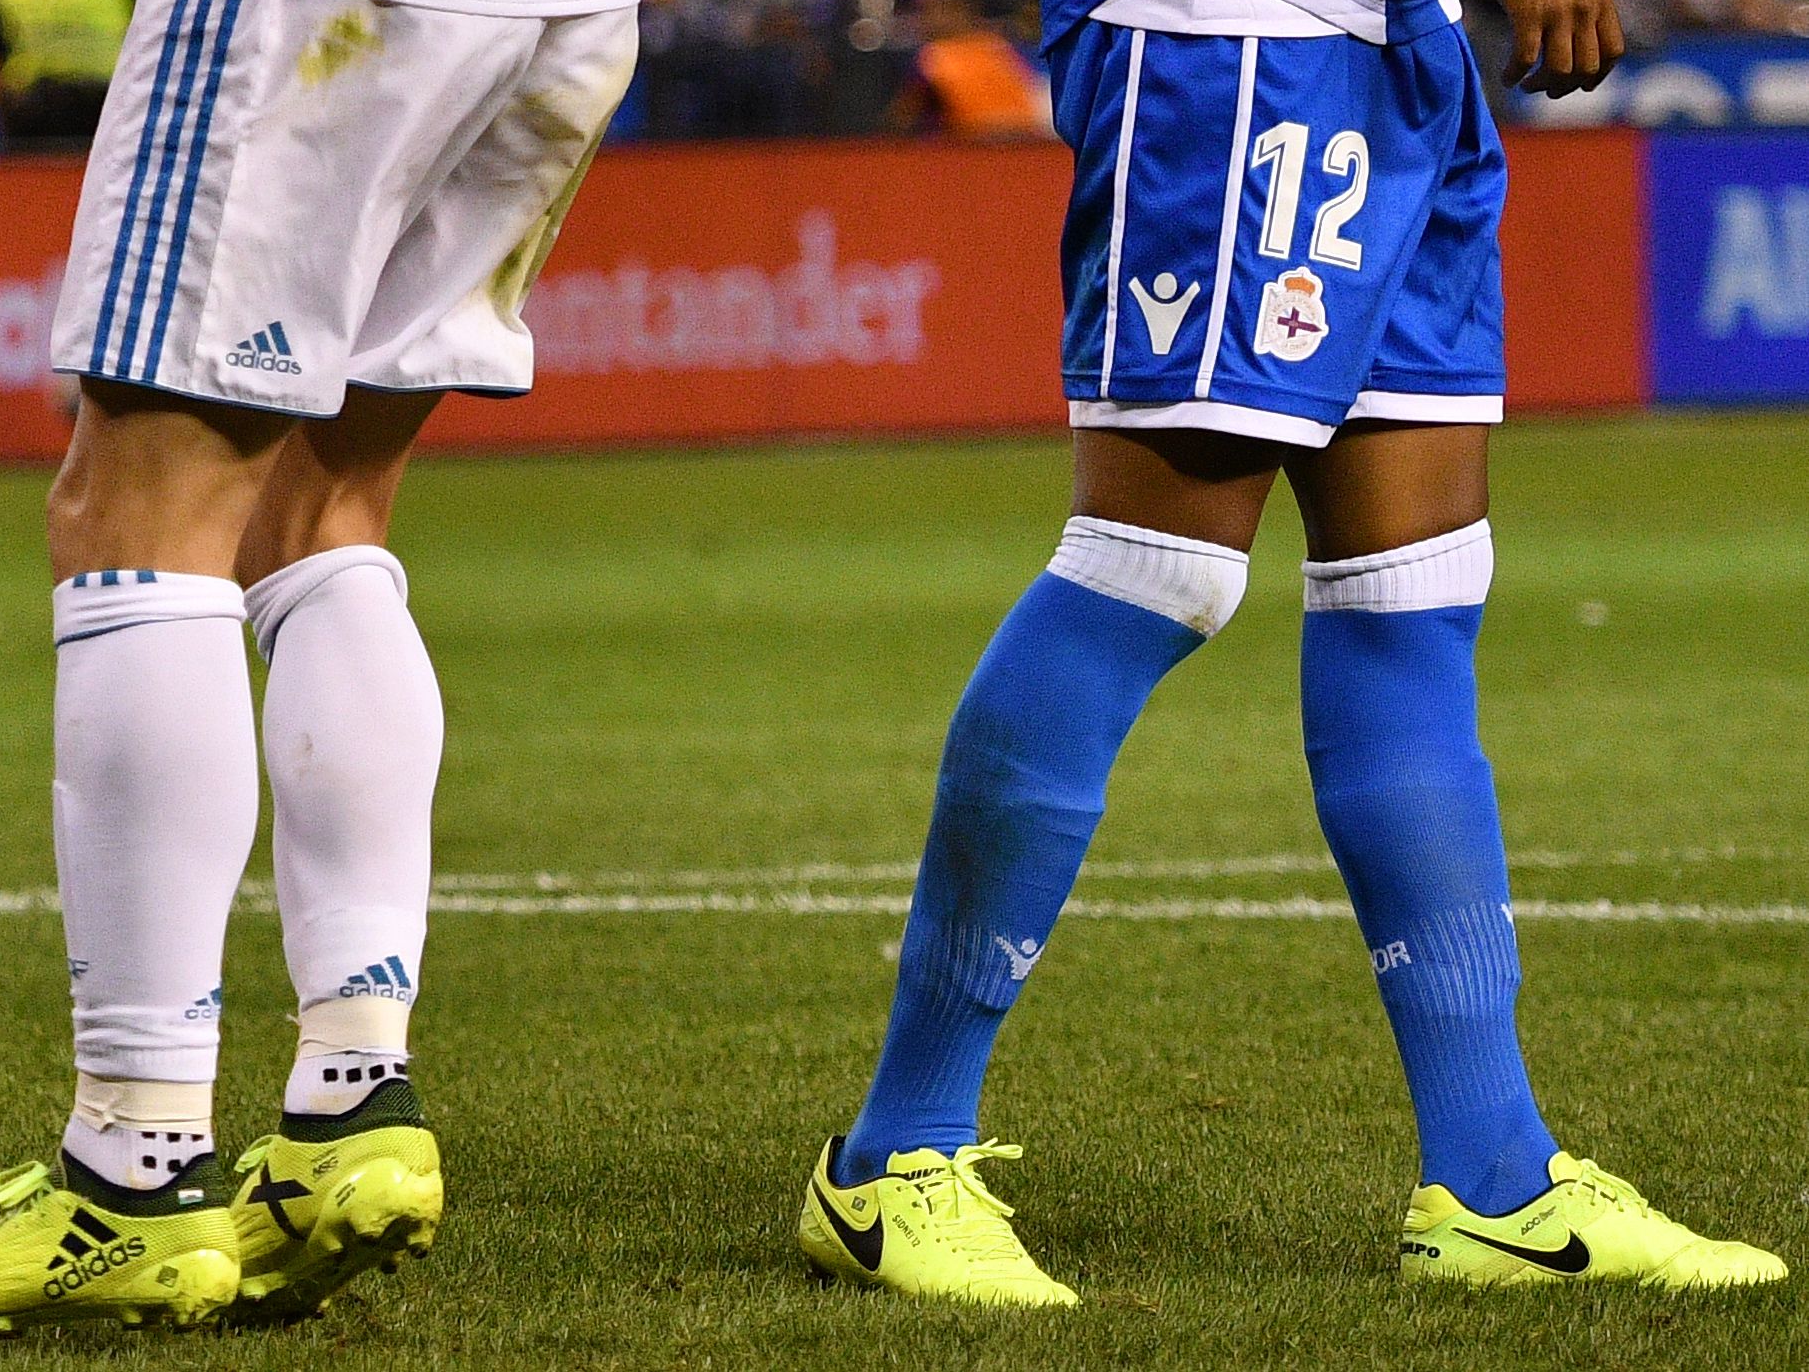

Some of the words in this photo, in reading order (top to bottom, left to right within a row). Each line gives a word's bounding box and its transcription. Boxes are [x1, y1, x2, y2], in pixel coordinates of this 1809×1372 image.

[1252, 121, 1370, 272] 12
[225, 347, 303, 376] adidas
[43, 1233, 146, 1301] adidas
